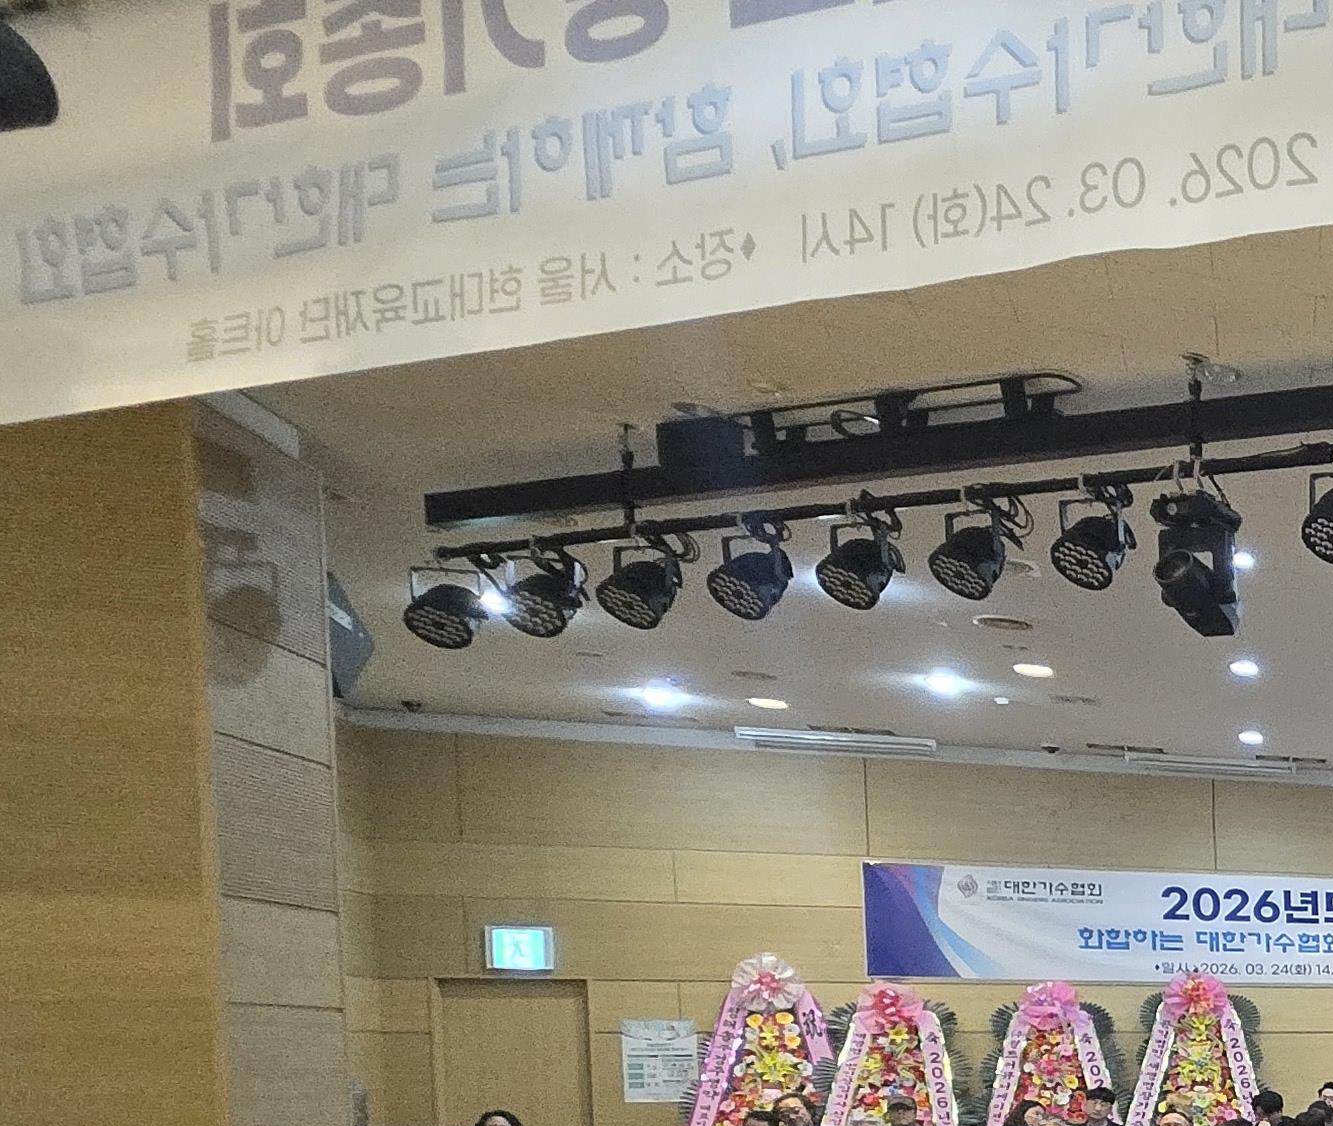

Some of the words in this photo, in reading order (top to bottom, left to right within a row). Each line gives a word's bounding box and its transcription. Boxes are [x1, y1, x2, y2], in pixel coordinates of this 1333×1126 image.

[1004, 880, 1102, 897] 대한가수협회
[1077, 926, 1184, 952] 화합하는
[1162, 961, 1190, 973] 일시
[1202, 962, 1242, 975] 2026.
[1246, 963, 1268, 975] 03.
[1271, 963, 1312, 977] 24(화)
